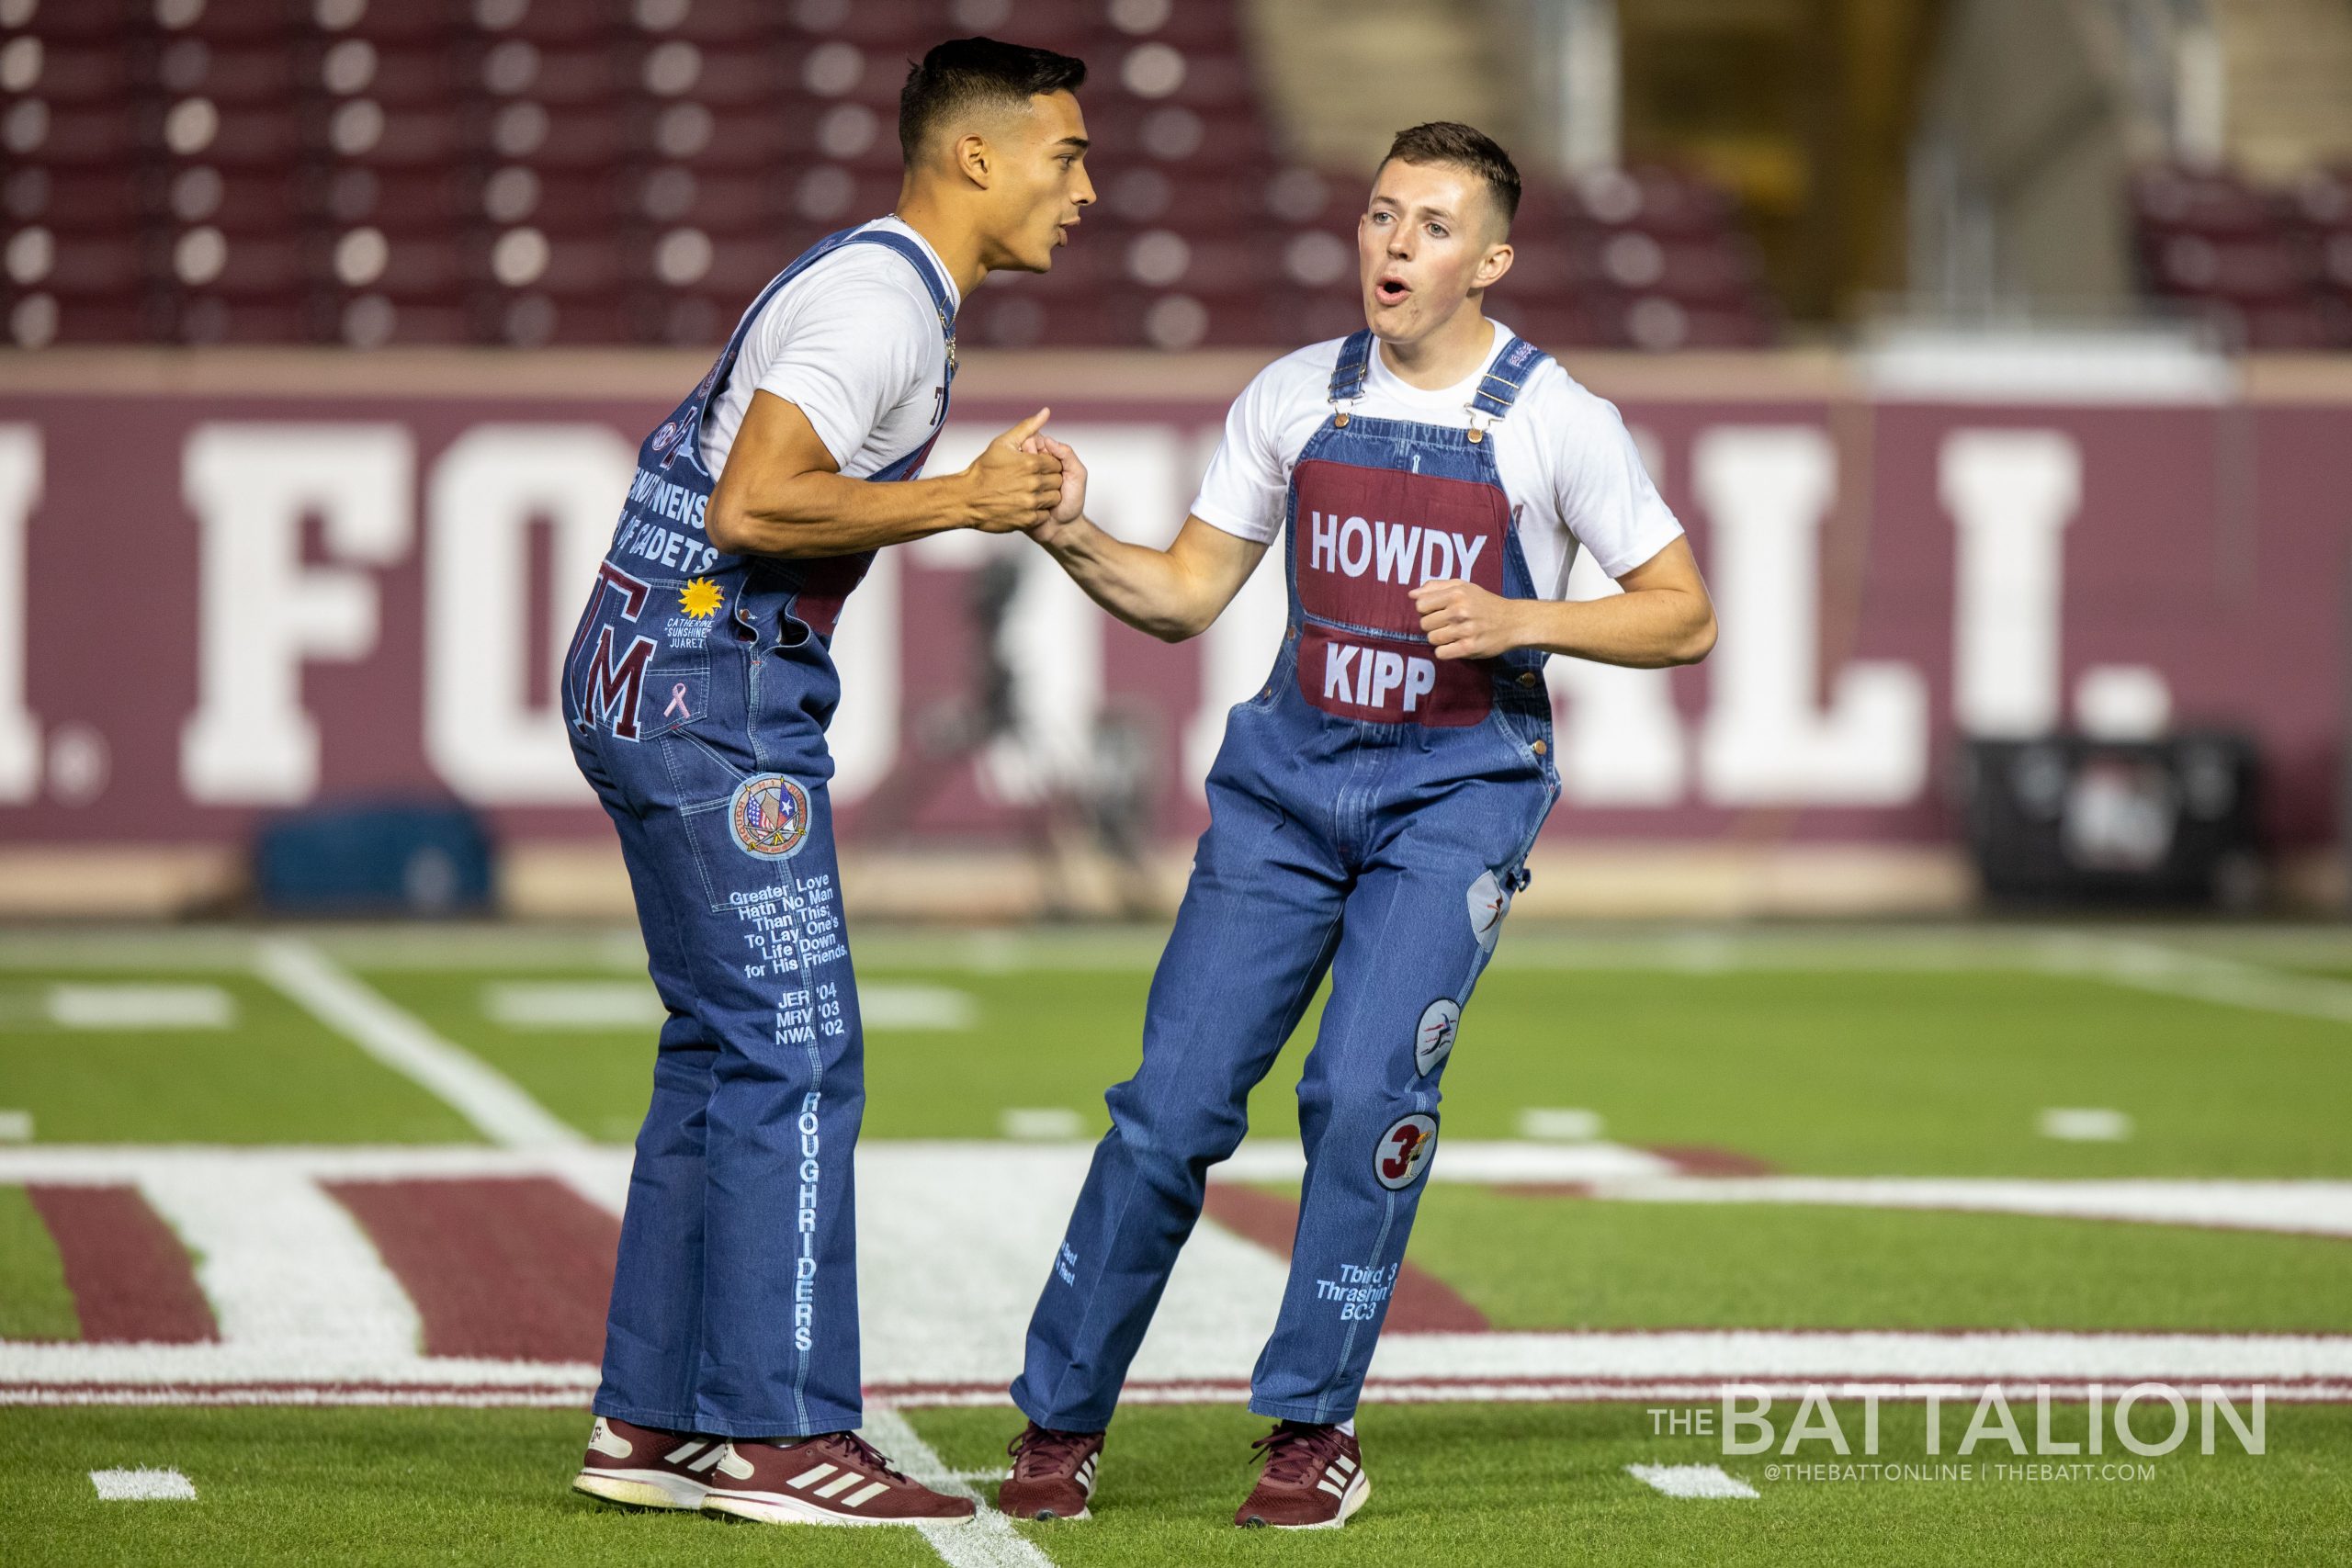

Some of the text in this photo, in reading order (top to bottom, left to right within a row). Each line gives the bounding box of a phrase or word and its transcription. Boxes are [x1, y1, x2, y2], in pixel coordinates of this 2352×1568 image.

[629, 524, 719, 574] CADETS
[1311, 511, 1487, 587] HOWDY
[667, 617, 715, 628] CATHERINE
[669, 637, 705, 649] JUAREZ
[1324, 643, 1437, 712] KIPP
[729, 874, 830, 906] Greater Love
[738, 887, 834, 920] Hath No Man
[744, 915, 840, 949] To Lay One's
[752, 913, 793, 932] Than
[762, 932, 836, 961] Life Down
[744, 964, 766, 979] for
[772, 956, 799, 975] His
[778, 981, 838, 1010] JER '04
[776, 1000, 841, 1029] MRV '03
[775, 1019, 845, 1045] NWA '02
[795, 1091, 821, 1352] ROUGHRIDERS
[1341, 1263, 1385, 1283] Tbird
[1340, 1302, 1377, 1321] BC3
